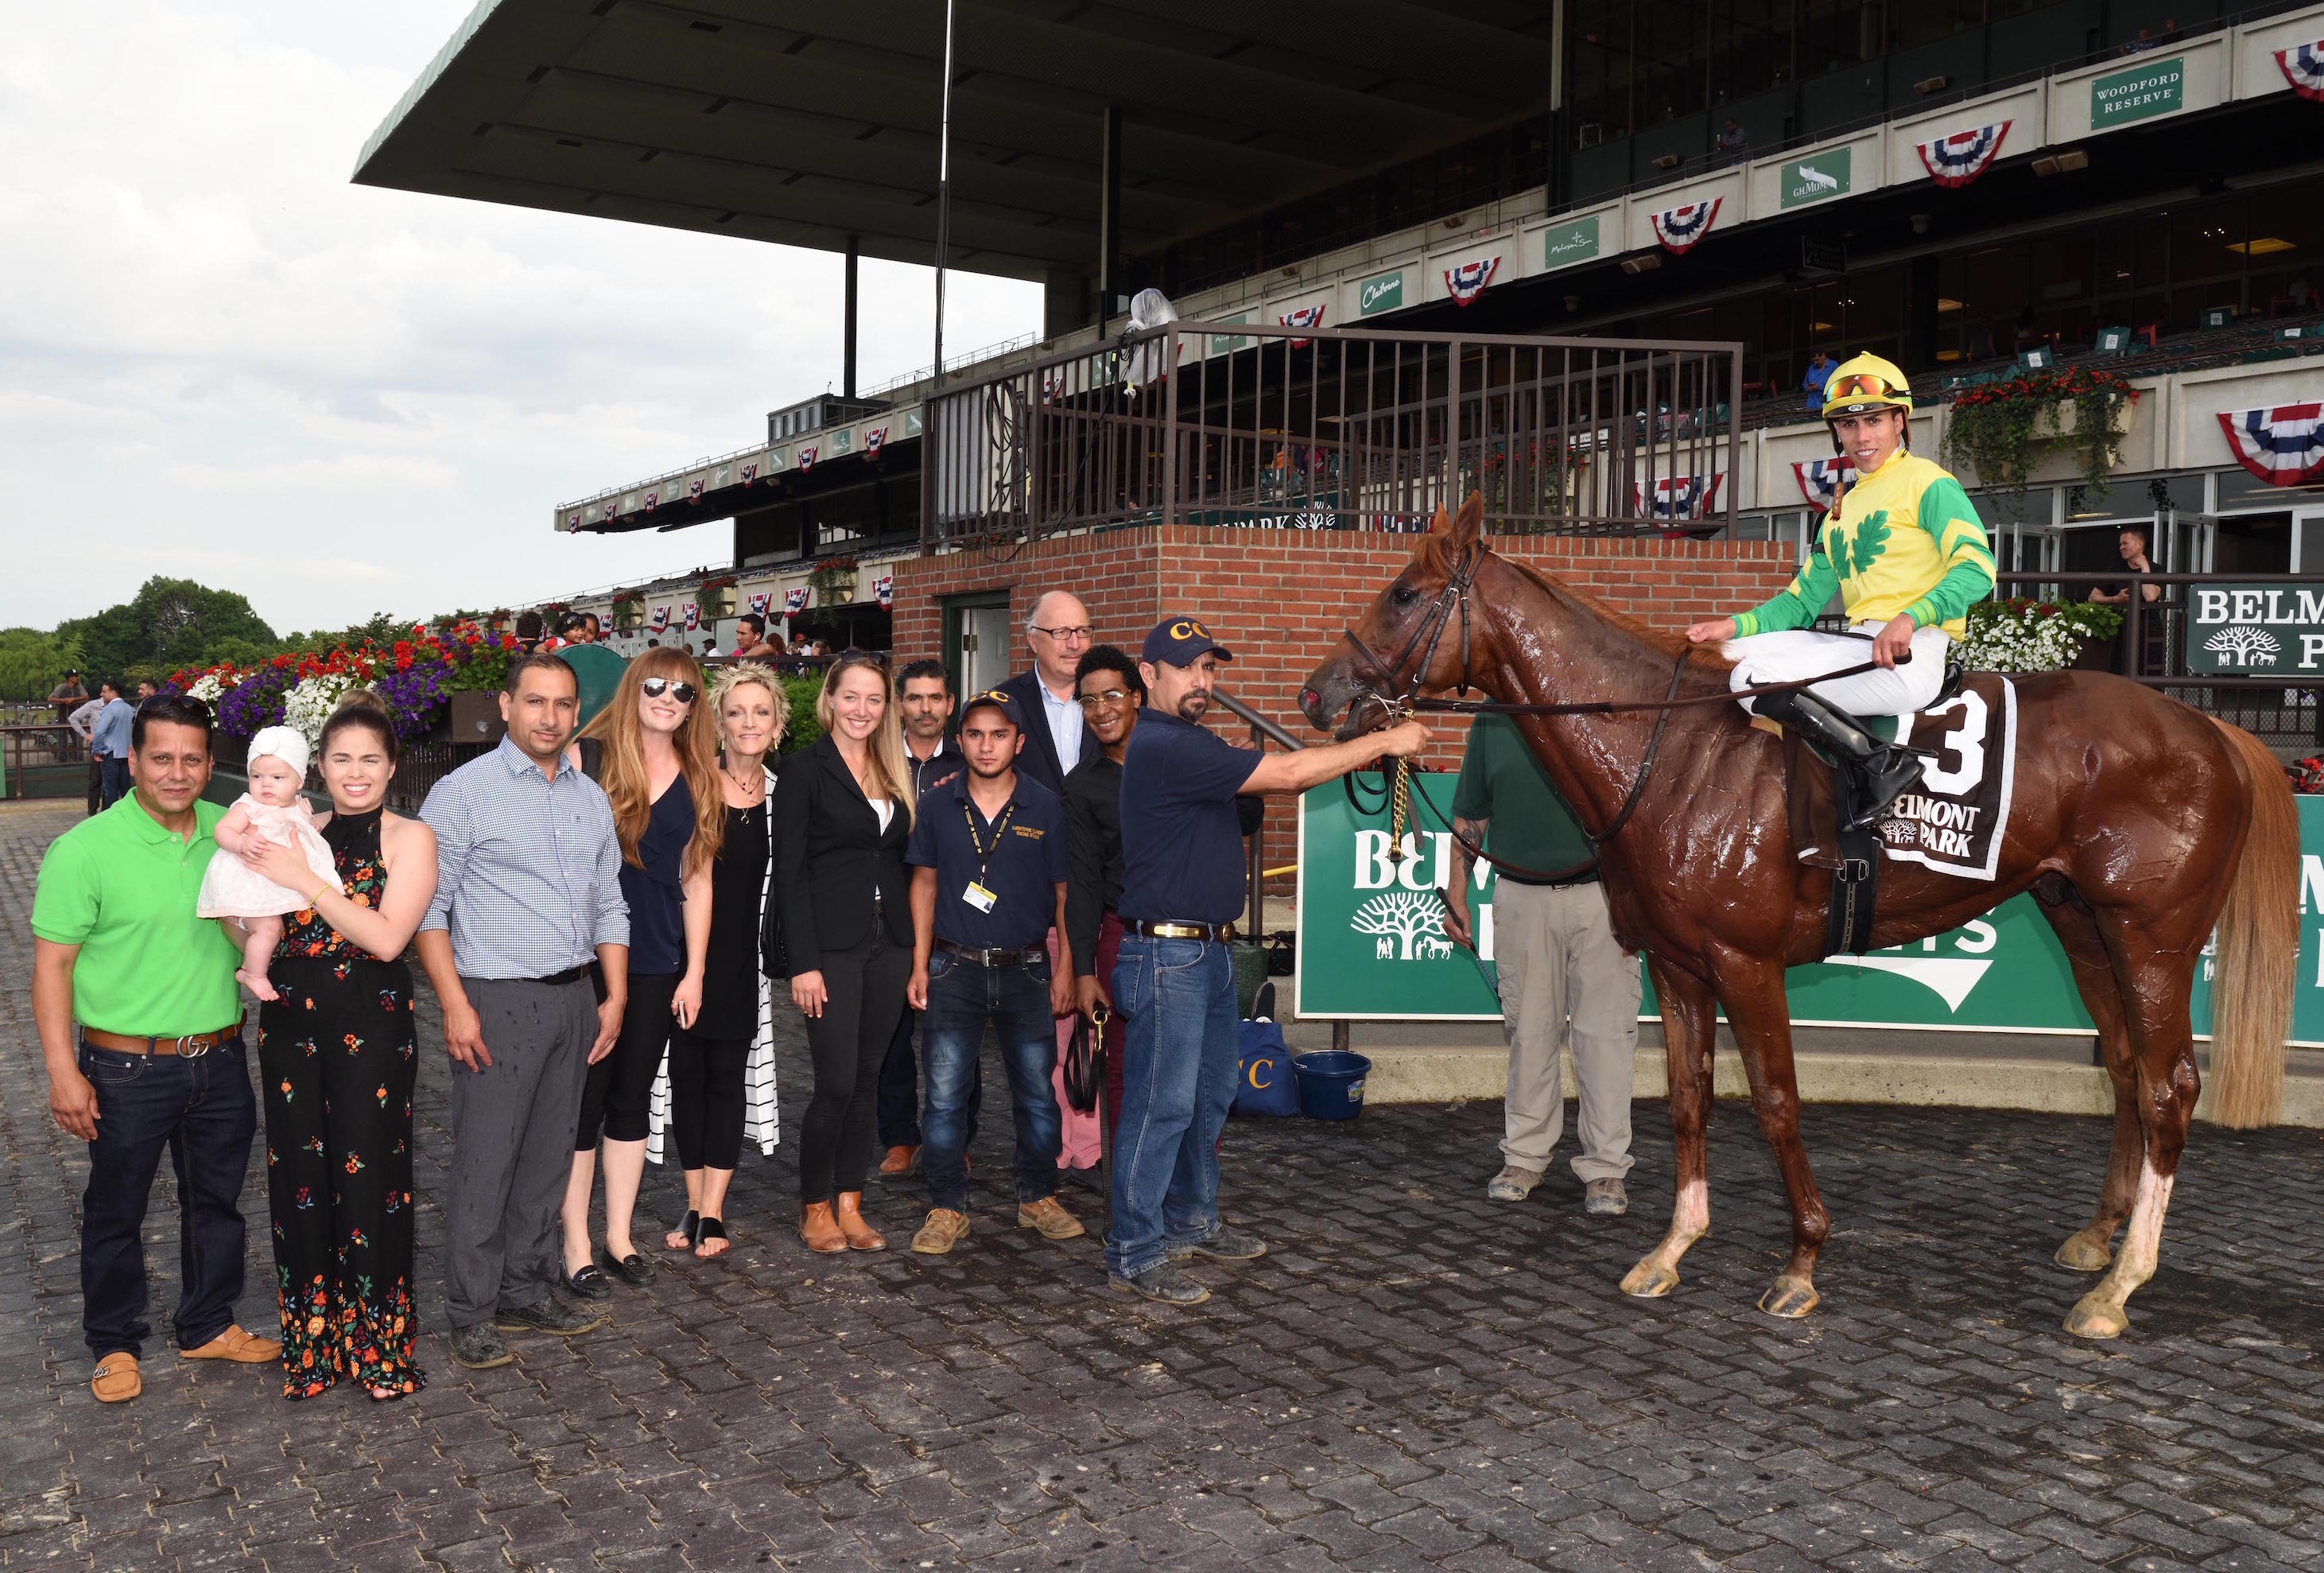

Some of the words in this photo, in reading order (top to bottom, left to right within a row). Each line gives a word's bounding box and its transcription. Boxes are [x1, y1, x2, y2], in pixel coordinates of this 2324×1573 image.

[2097, 72, 2179, 100] WOODFORD
[2104, 88, 2172, 114] RESERVE
[1362, 279, 1401, 309] Claiborne
[1170, 621, 1209, 640] CC
[969, 689, 1009, 703] CC
[1919, 822, 1975, 858] PARK
